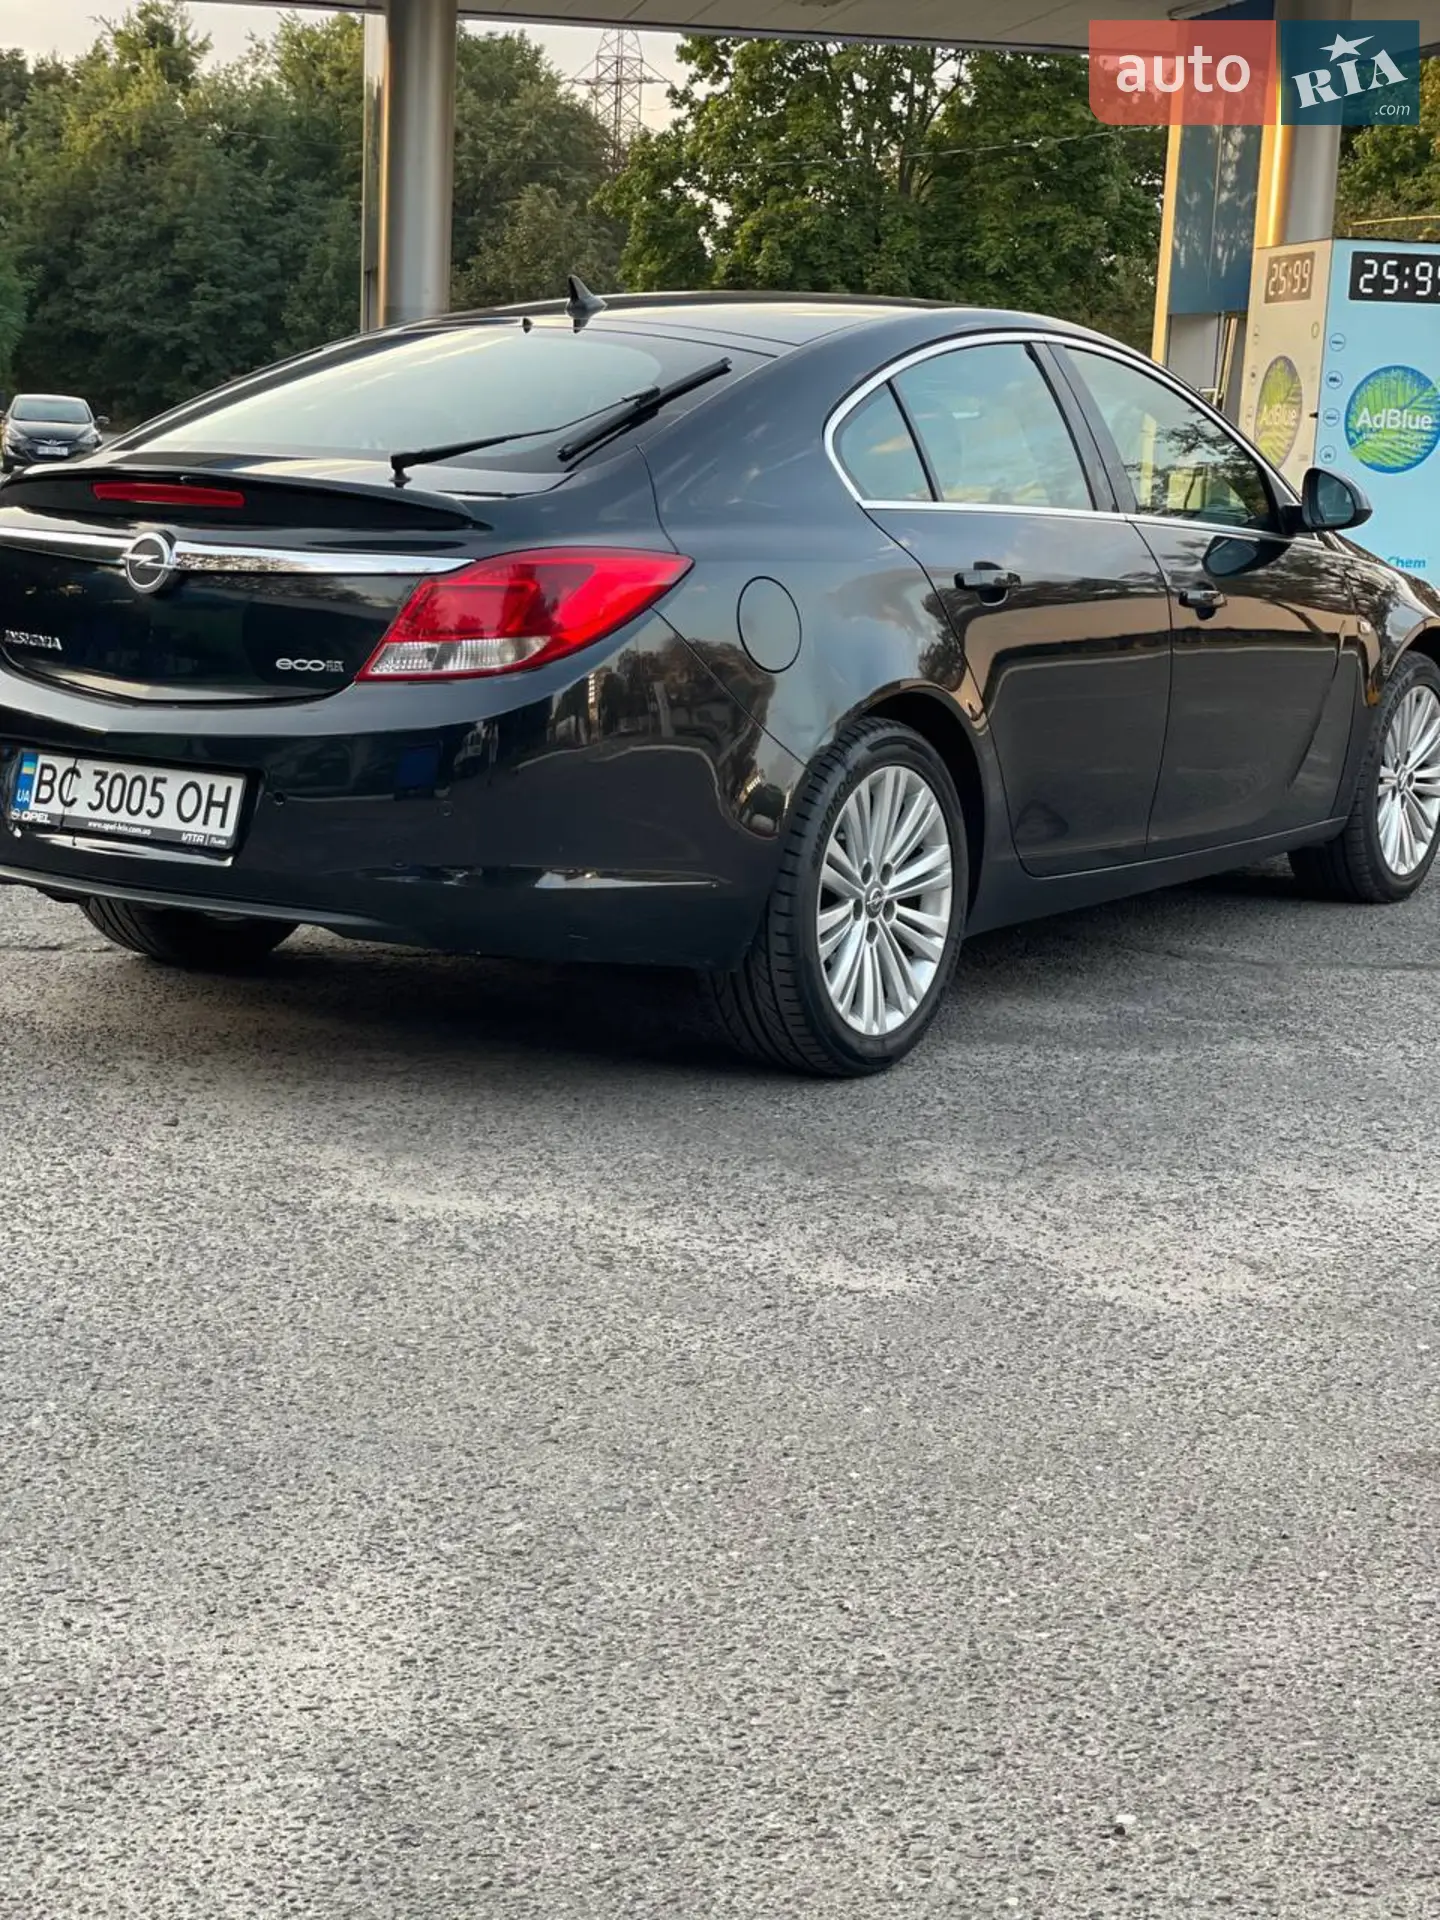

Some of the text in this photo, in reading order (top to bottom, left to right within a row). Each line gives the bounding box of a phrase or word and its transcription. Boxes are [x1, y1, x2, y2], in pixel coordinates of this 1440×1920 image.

[1359, 258, 1440, 297] 25:9
[1259, 403, 1298, 426] AdBlue
[1356, 407, 1433, 430] AdBlue
[5, 629, 62, 651] INSIGNIA
[16, 788, 30, 803] UA
[88, 769, 168, 818] 3005
[176, 780, 233, 828] OH
[21, 810, 51, 824] OPEL
